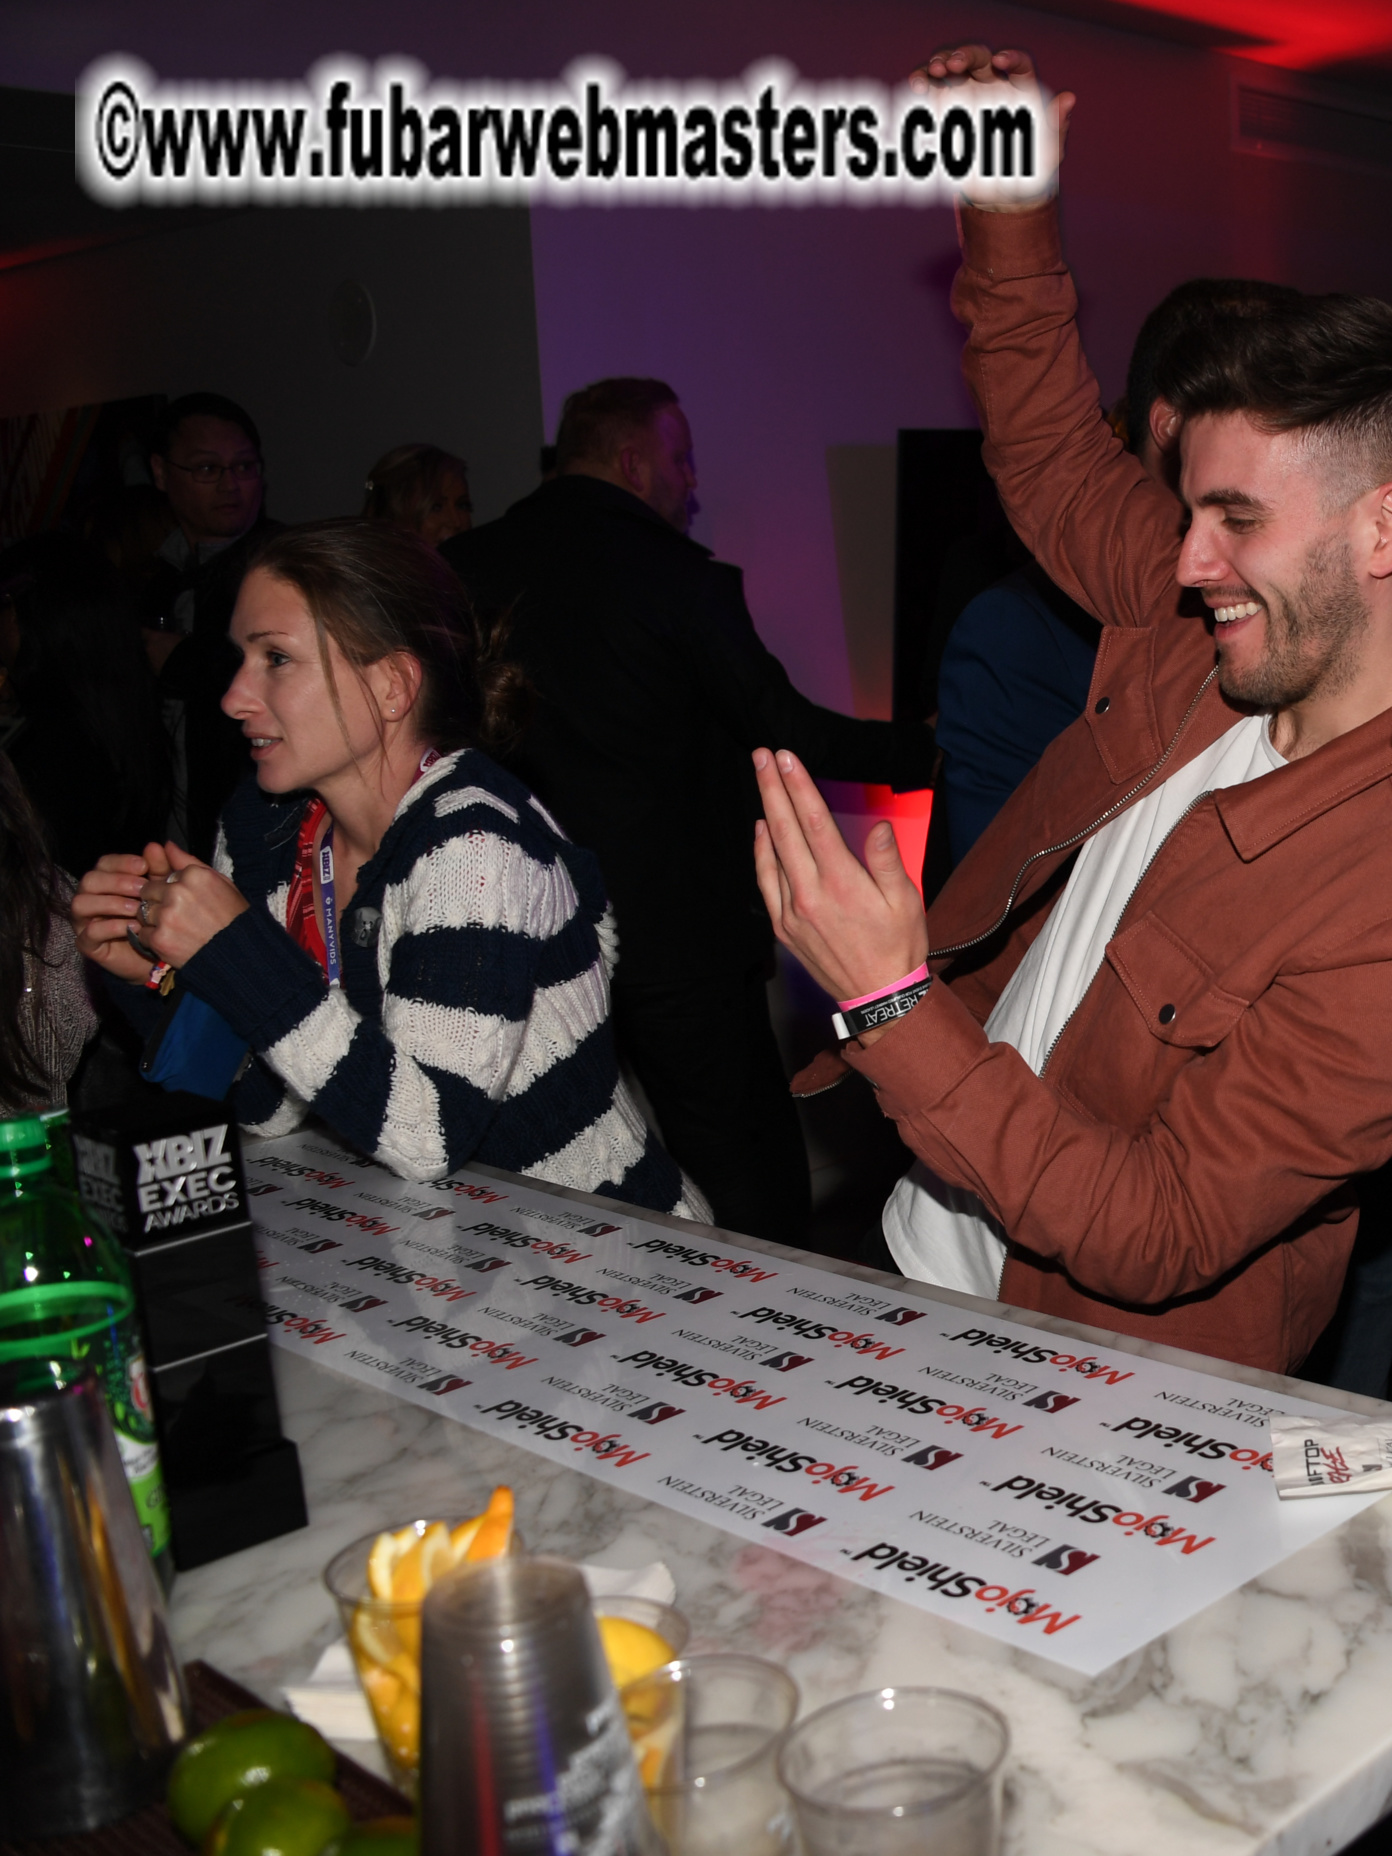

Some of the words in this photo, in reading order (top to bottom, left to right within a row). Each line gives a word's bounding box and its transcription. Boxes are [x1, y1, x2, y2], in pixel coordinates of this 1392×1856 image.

[326, 907, 337, 965] MANYVIDS
[865, 995, 918, 1027] RETREAT
[132, 1123, 233, 1185] XBIZ
[137, 1165, 237, 1214] EXEC
[352, 1191, 421, 1213] SILVERSTEIN
[396, 1195, 433, 1209] LEGAL
[143, 1191, 240, 1234] AWARDS
[509, 1206, 585, 1230] SILVERSTEIN
[556, 1210, 596, 1225] LEGAL
[284, 1226, 321, 1242] LEGAL
[398, 1238, 470, 1264] SILVERSTEIN
[441, 1243, 486, 1259] LEGAL
[274, 1275, 345, 1304] SILVERSTEIN
[322, 1280, 363, 1298] LEGAL
[595, 1267, 681, 1295] SILVERSTEIN
[648, 1272, 692, 1289] LEGAL
[785, 1286, 877, 1316] SILVERSTEIN
[844, 1291, 892, 1310] LEGAL
[476, 1305, 558, 1336] SILVERSTEIN
[531, 1312, 576, 1330] LEGAL
[670, 1328, 763, 1361] SILVERSTEIN
[730, 1334, 779, 1354] LEGAL
[343, 1349, 424, 1383] SILVERSTEIN
[397, 1356, 443, 1378] LEGAL
[540, 1375, 632, 1412] SILVERSTEIN
[600, 1382, 650, 1405] LEGAL
[917, 1365, 1024, 1401] SILVERSTEIN
[984, 1372, 1039, 1394] LEGAL
[1153, 1390, 1270, 1427] SILVERSTEIN
[795, 1416, 904, 1456] SILVERSTEIN
[865, 1424, 921, 1449] LEGAL
[1040, 1446, 1162, 1488] SILVERSTEIN
[1115, 1454, 1177, 1480] LEGAL
[656, 1474, 765, 1520] SILVERSTEIN
[727, 1484, 785, 1511] LEGAL
[908, 1509, 1033, 1557] SILVERSTEIN
[987, 1519, 1051, 1548] LEGAL
